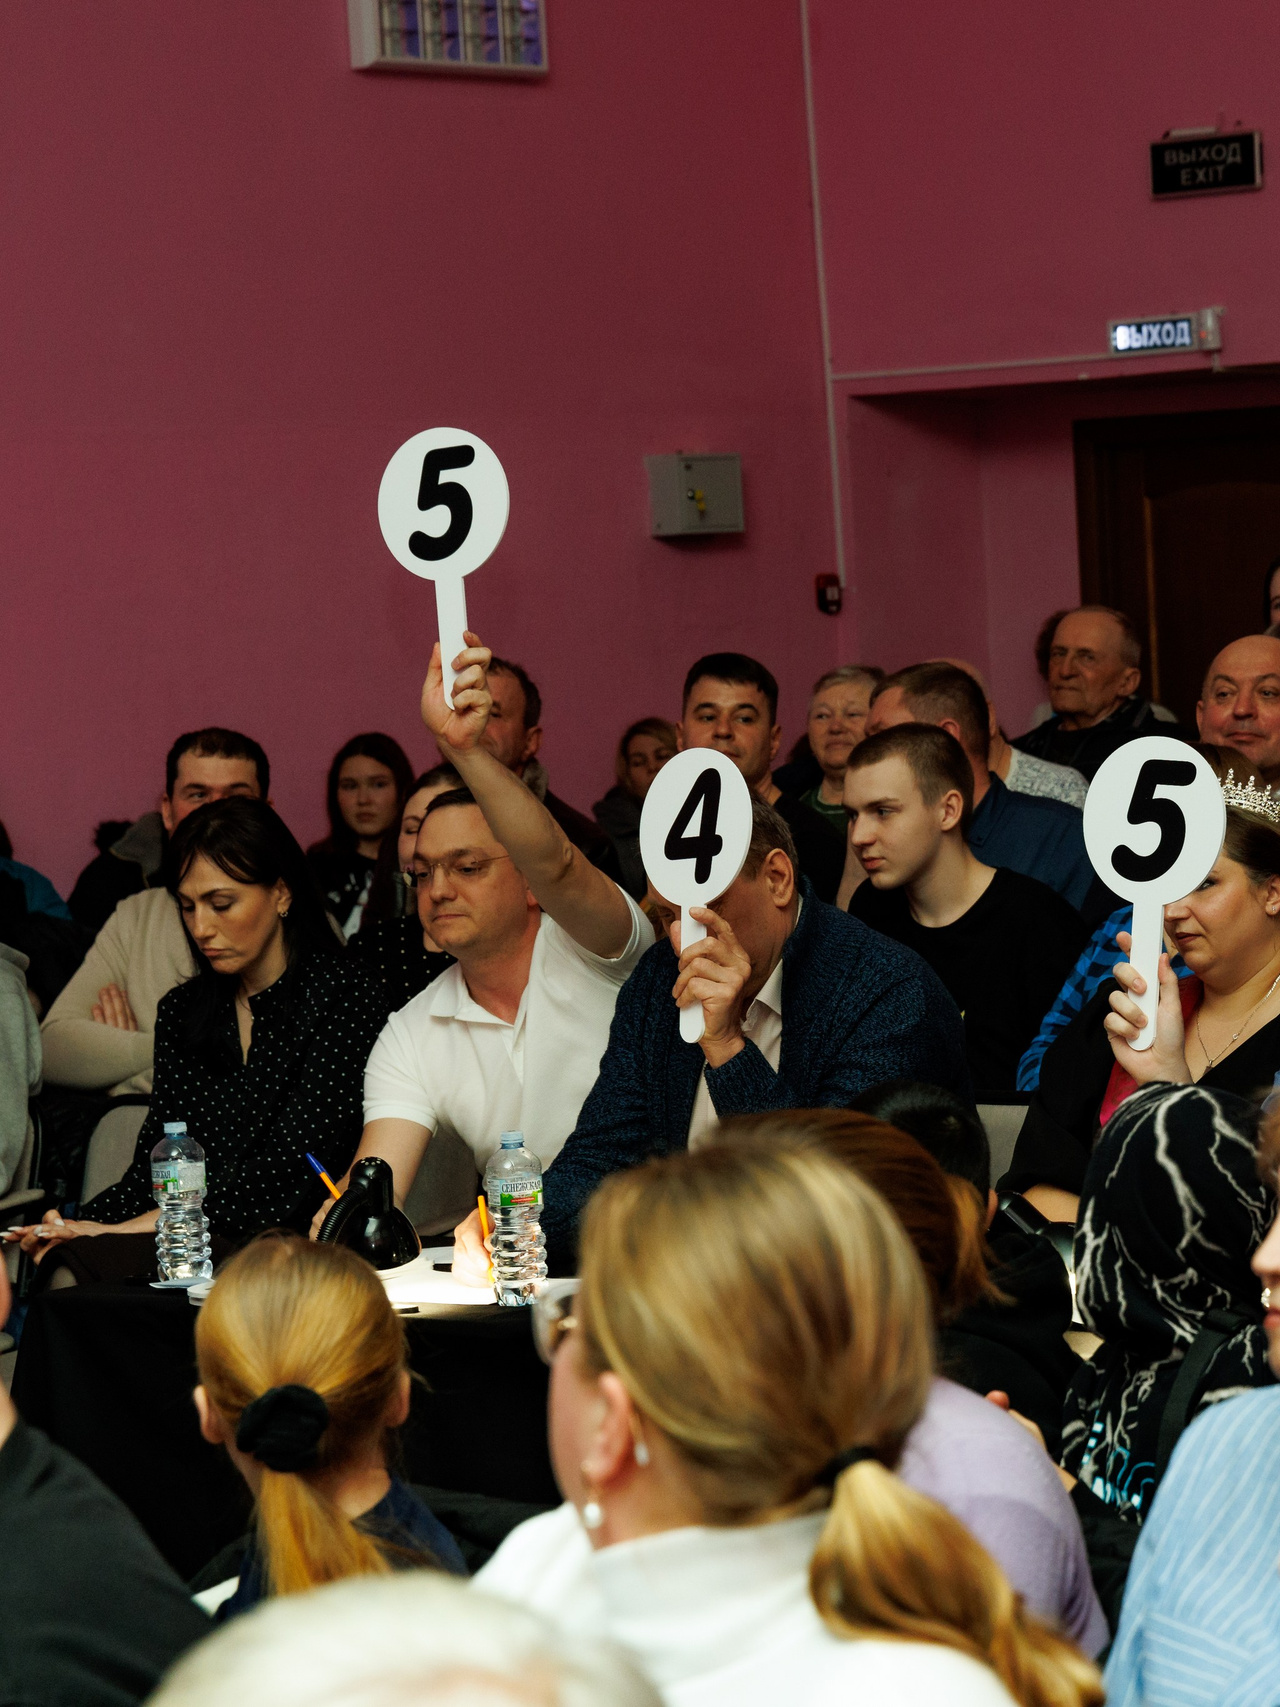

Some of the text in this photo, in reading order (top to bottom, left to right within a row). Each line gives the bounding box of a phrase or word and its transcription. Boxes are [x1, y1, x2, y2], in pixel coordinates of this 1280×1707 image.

[1164, 142, 1242, 166] ВЫХОД
[1180, 165, 1226, 186] EXIT
[1116, 321, 1191, 350] ВЫХОД
[409, 445, 475, 561] 5
[664, 768, 722, 884] 4
[1111, 759, 1196, 882] 5
